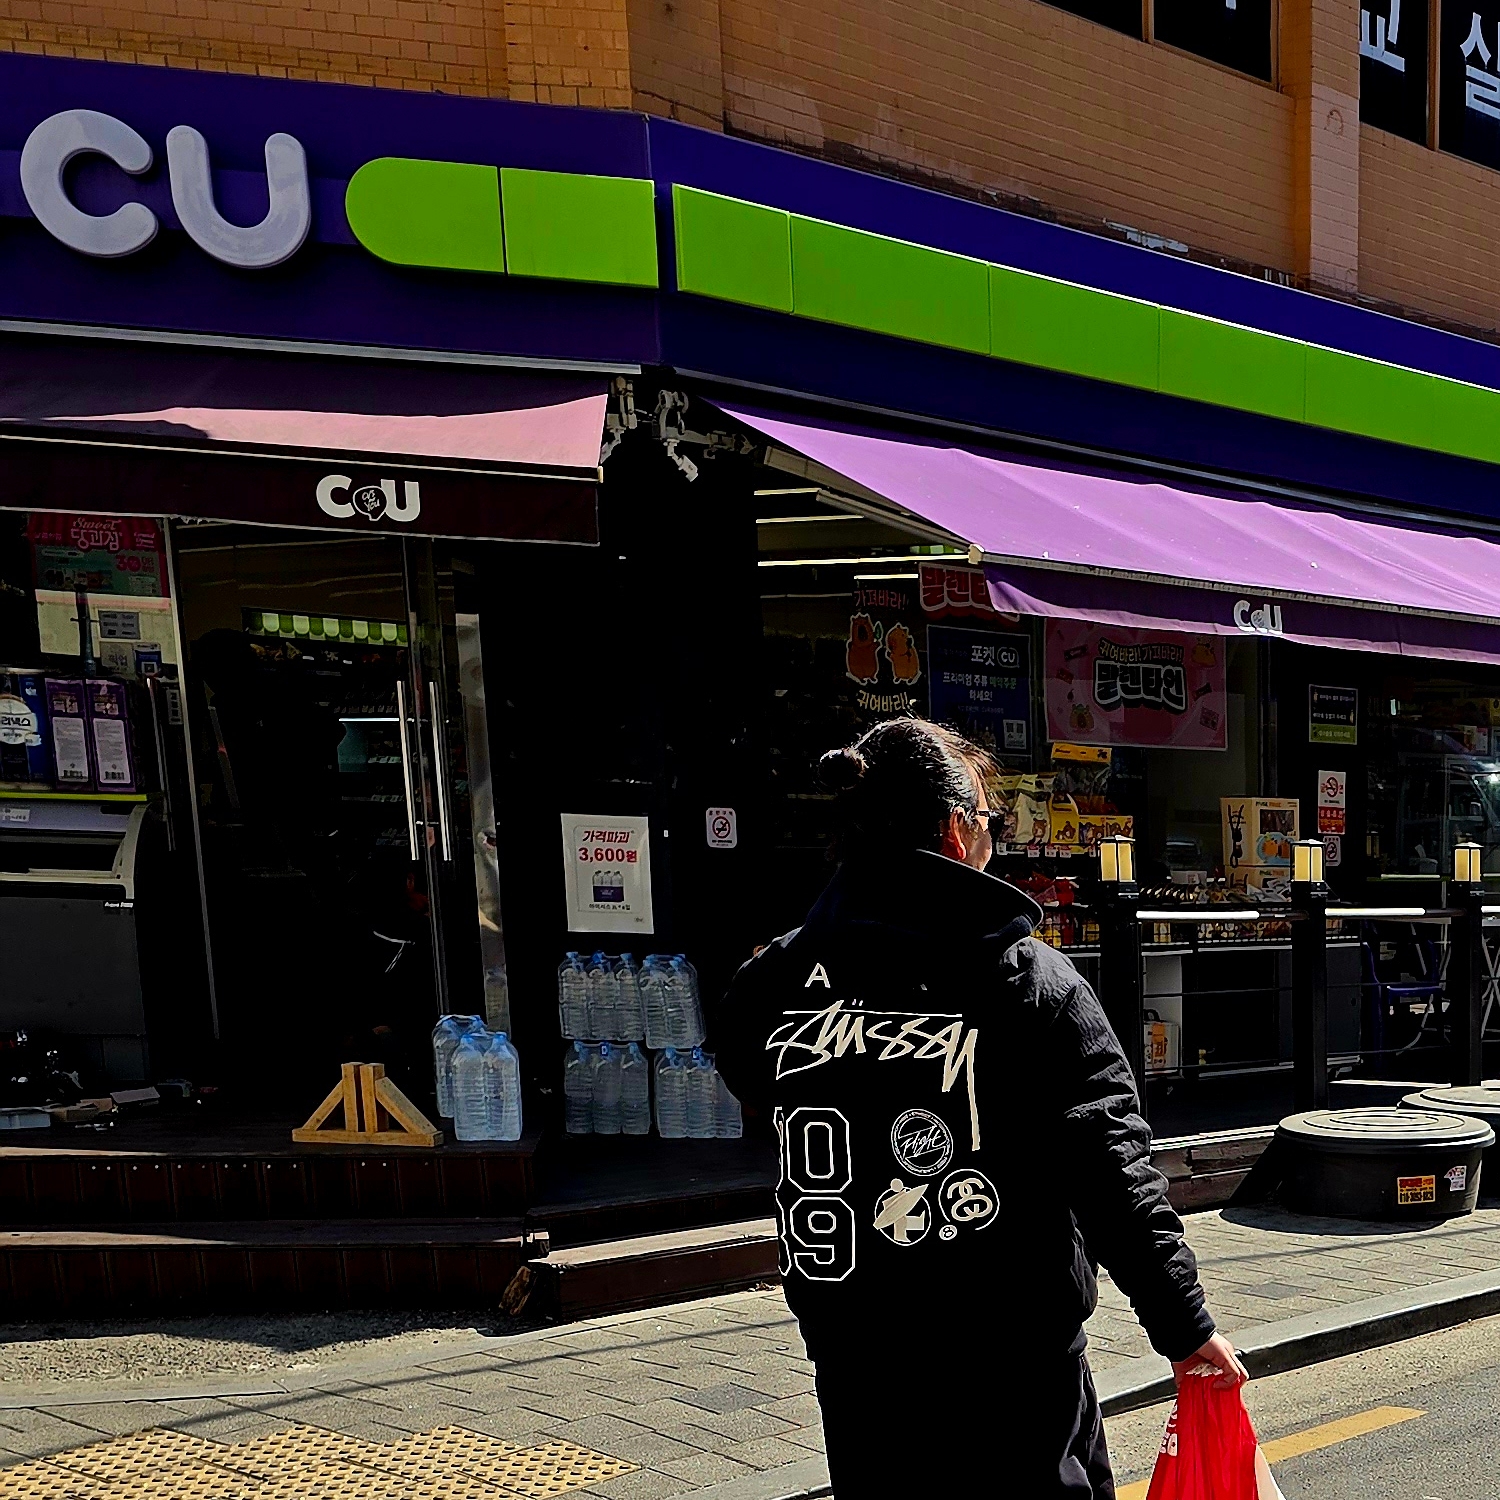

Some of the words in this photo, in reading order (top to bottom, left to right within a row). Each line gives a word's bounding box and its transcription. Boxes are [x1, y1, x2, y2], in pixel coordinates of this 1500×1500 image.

[20, 109, 312, 269] CU
[582, 830, 631, 843] 가격파괴
[578, 847, 637, 864] 3,600원
[805, 963, 831, 989] A
